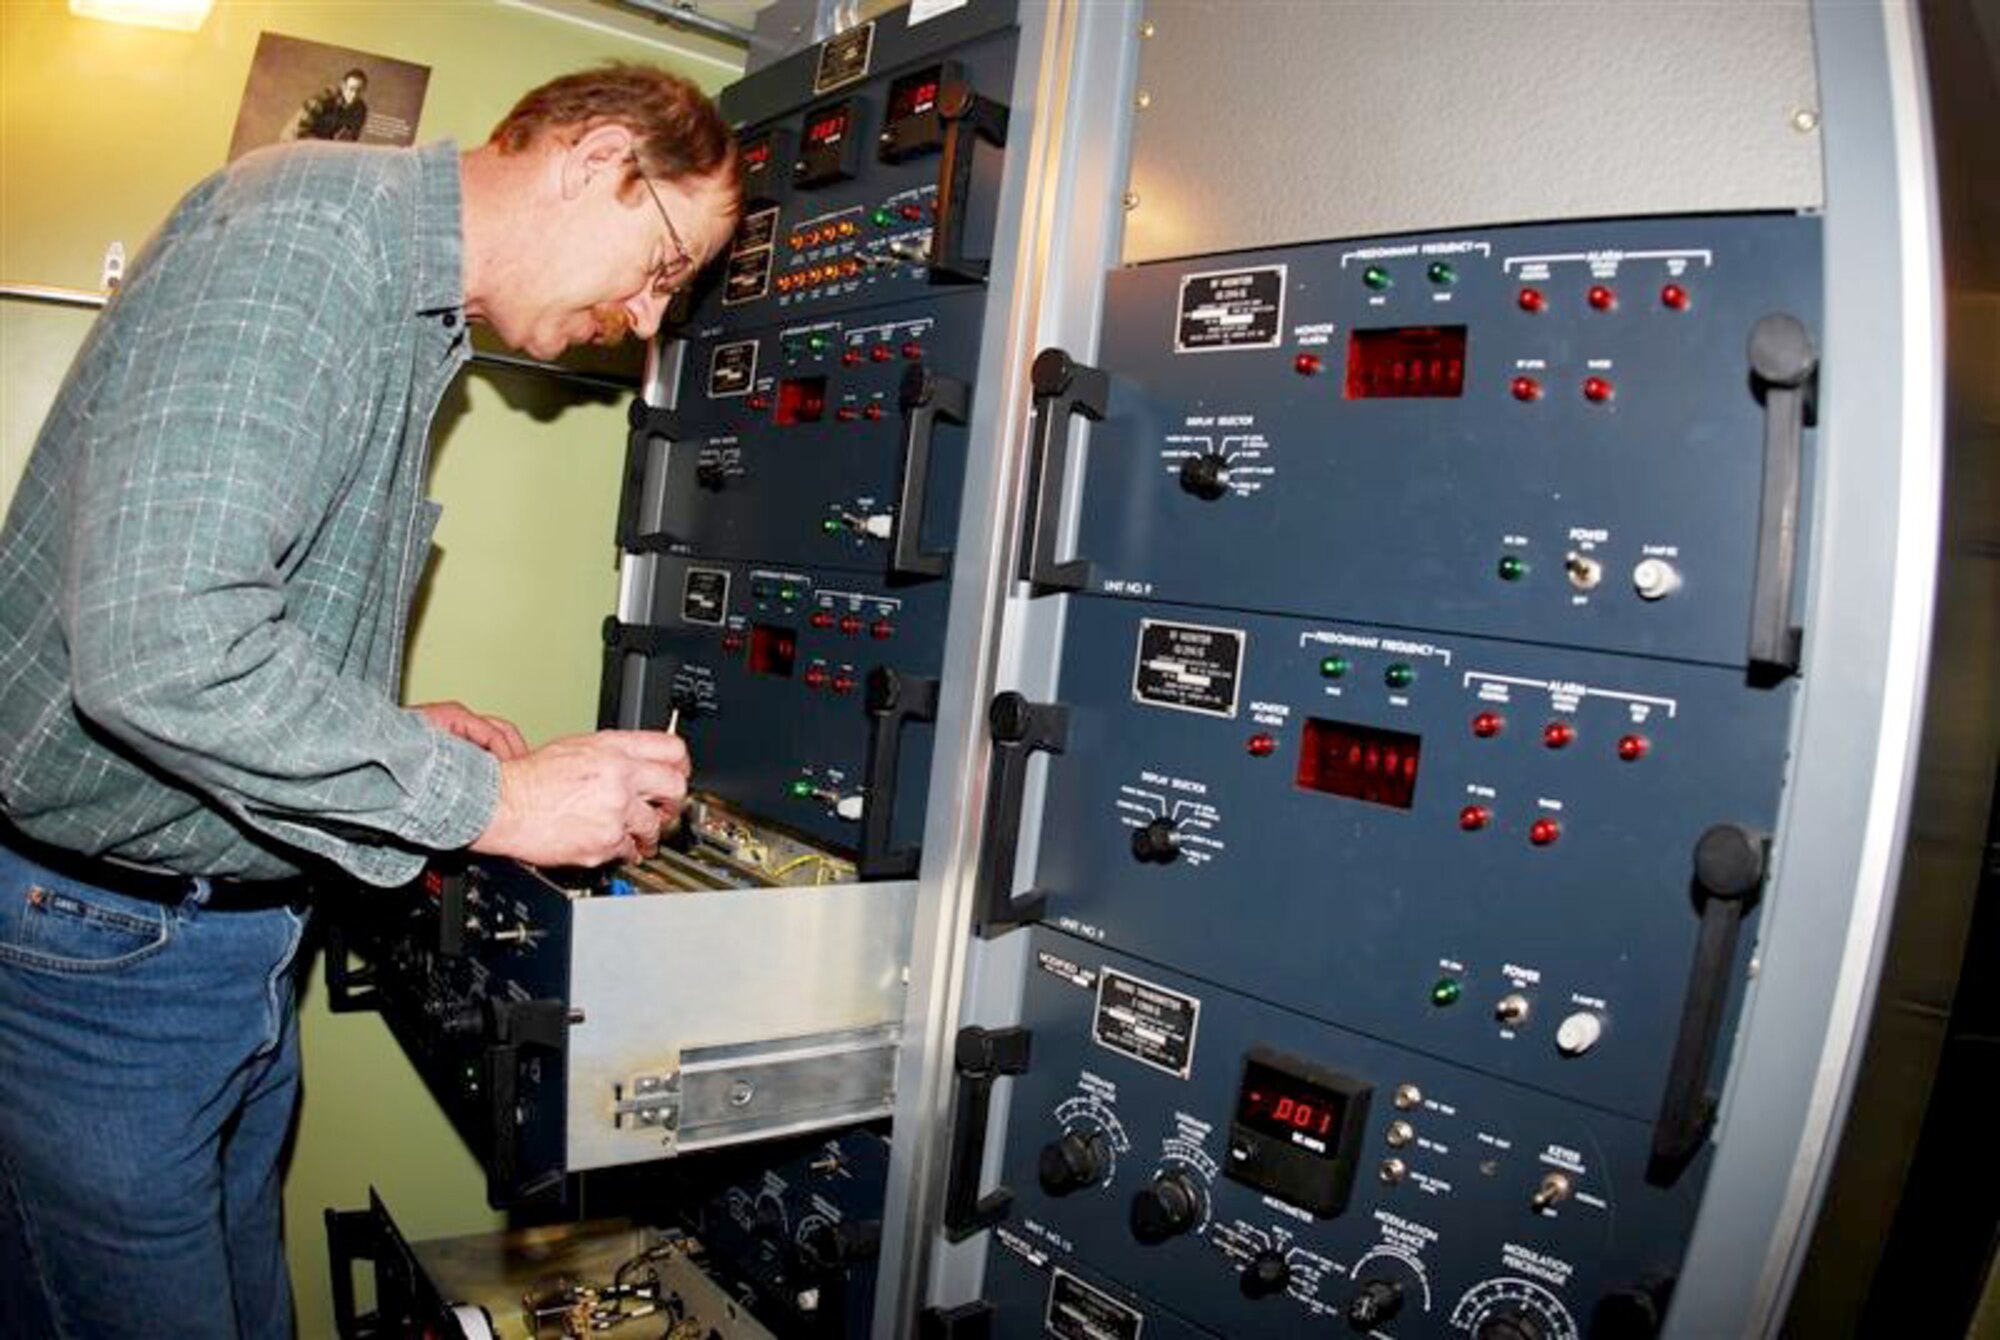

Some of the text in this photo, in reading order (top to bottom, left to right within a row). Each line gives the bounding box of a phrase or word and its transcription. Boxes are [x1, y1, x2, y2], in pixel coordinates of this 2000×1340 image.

[1422, 242, 1474, 254] FREQUENCY
[1586, 250, 1624, 261] ALARM
[1294, 323, 1334, 335] MONITOR
[1298, 335, 1328, 344] ALARM
[1217, 415, 1253, 426] SELECTOR
[1569, 528, 1609, 542] POWER
[1104, 580, 1125, 592] UNIT
[1382, 639, 1435, 655] FREQUENCY
[1548, 680, 1586, 695] ALARM
[1250, 701, 1290, 716] MONITOR
[1253, 713, 1283, 726] ALARM
[1171, 778, 1207, 794] SELECTOR
[1059, 916, 1080, 931] UNIT
[1502, 963, 1541, 983] POWER
[1024, 1219, 1045, 1237] UNIT
[1374, 1209, 1439, 1242] MODULATION
[1381, 1223, 1426, 1250] BALANCE
[1502, 1241, 1574, 1275] MODULATION
[1502, 1254, 1567, 1287] PERCENTAGE
